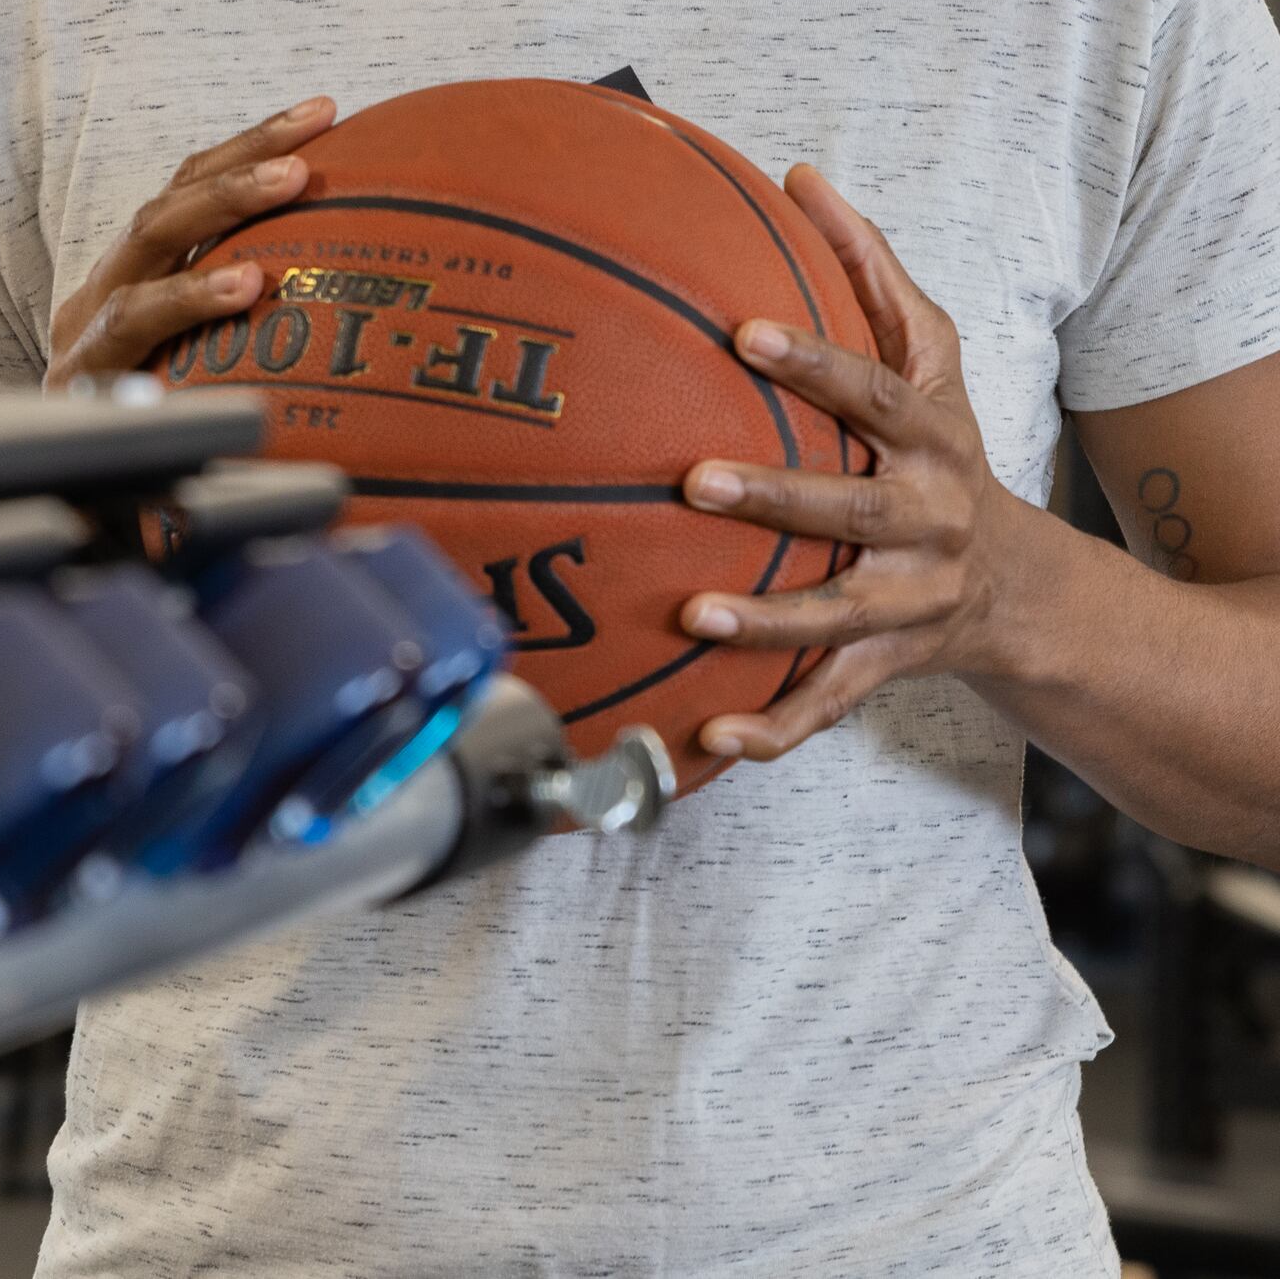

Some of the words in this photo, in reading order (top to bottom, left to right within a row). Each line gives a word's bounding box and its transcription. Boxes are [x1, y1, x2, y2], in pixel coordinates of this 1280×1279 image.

[316, 242, 430, 266] CHANNEL
[443, 257, 514, 280] DEEP
[167, 305, 565, 419] TF-1000
[285, 404, 341, 429] 28.5
